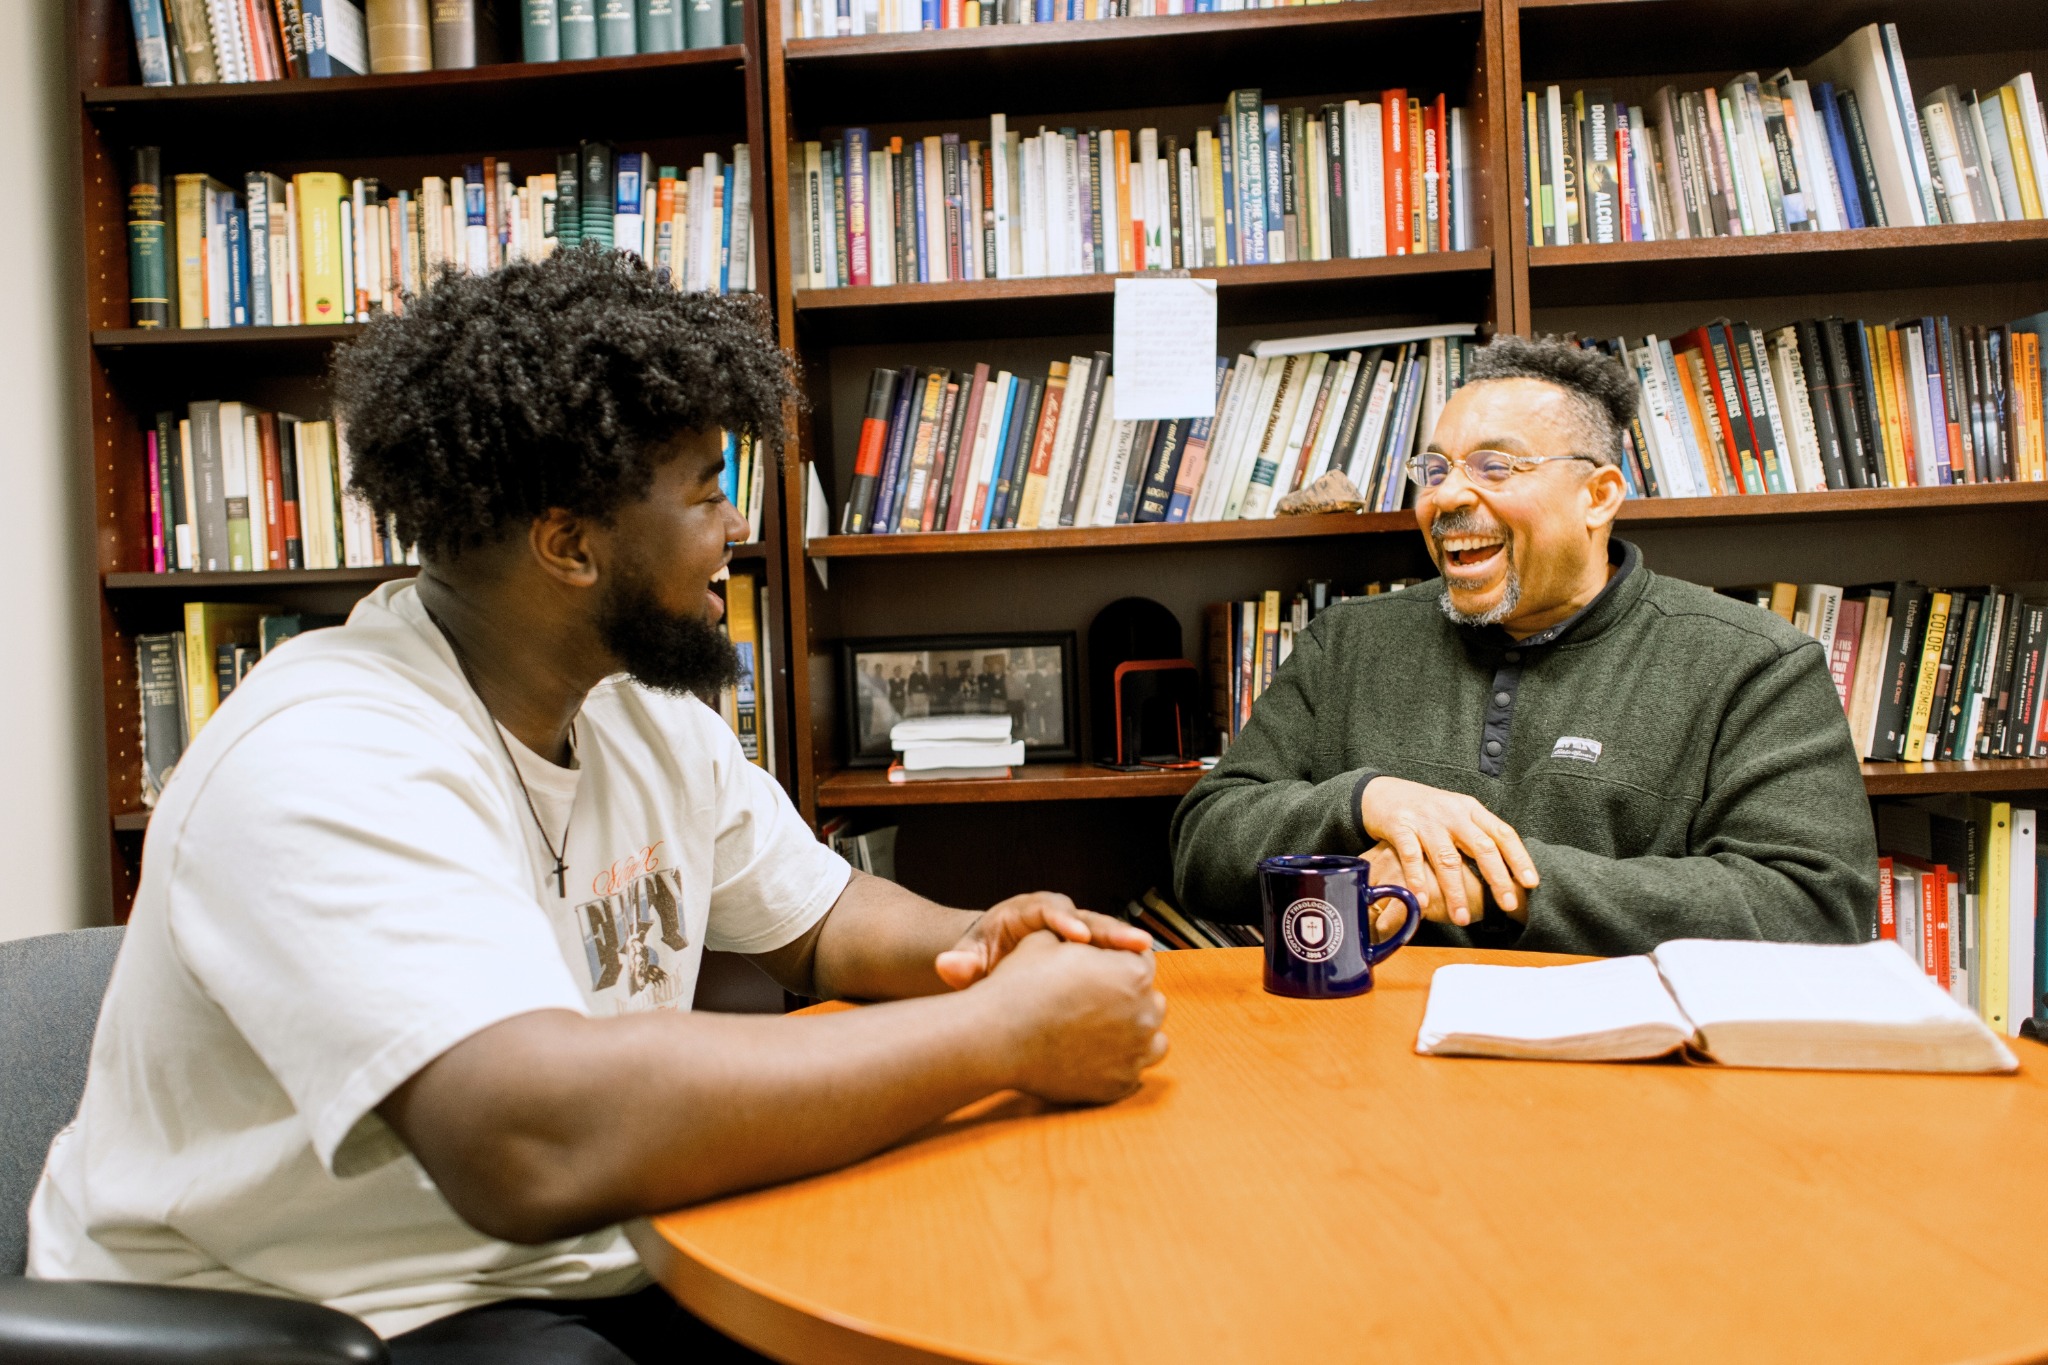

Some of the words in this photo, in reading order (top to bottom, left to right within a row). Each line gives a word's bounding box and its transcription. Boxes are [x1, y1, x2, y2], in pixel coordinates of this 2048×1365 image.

[1248, 112, 1259, 141] FROM
[1588, 103, 1609, 162] DOMINION
[1250, 144, 1261, 179] CHRIST
[1269, 150, 1279, 194] MISSION
[249, 182, 266, 226] PAUL
[1252, 182, 1262, 197] TO
[1253, 200, 1263, 219] THE
[1592, 190, 1615, 244] ALCORN
[853, 236, 867, 277] WARREN
[1254, 222, 1264, 261] WORLD
[1269, 353, 1300, 415] CONTEMPORARY
[1693, 356, 1712, 394] MANY
[1762, 376, 1778, 412] WHILE
[2028, 380, 2040, 421] Generation
[1163, 423, 1178, 442] and
[1257, 412, 1280, 455] PREACHING
[1702, 393, 1725, 443] COLORS
[1769, 413, 1786, 449] BLACK
[1961, 431, 1972, 451] 2.0
[1151, 438, 1177, 485] Preaching
[1820, 593, 1838, 642] WINNING
[1903, 598, 1920, 629] Urban
[1265, 636, 1274, 649] THE
[1924, 612, 1947, 654] COLOR
[1265, 651, 1274, 672] HEART
[2002, 647, 2015, 673] FAITH
[2027, 648, 2040, 674] BEFORE
[1914, 659, 1937, 718] COMPROMISE
[2026, 673, 2036, 688] THE
[2021, 687, 2035, 725] MAYFLOWER
[1994, 718, 2005, 738] VOLF
[1289, 901, 1336, 919] THEOLOGICAL
[1880, 867, 1894, 926] REPARATIONS
[1939, 872, 1948, 922] COMPASSION
[1948, 896, 1956, 915] THOU
[1285, 914, 1302, 953] COVENANT
[1926, 912, 1933, 921] OF
[1926, 923, 1934, 938] OUR
[1948, 915, 1956, 936] SHALT
[1326, 918, 1342, 954] SEMINARY
[1927, 938, 1935, 969] POLITICS
[1940, 930, 1949, 978] CONVICTION
[1949, 936, 1957, 951] NOT
[1949, 965, 1959, 987] JERK
